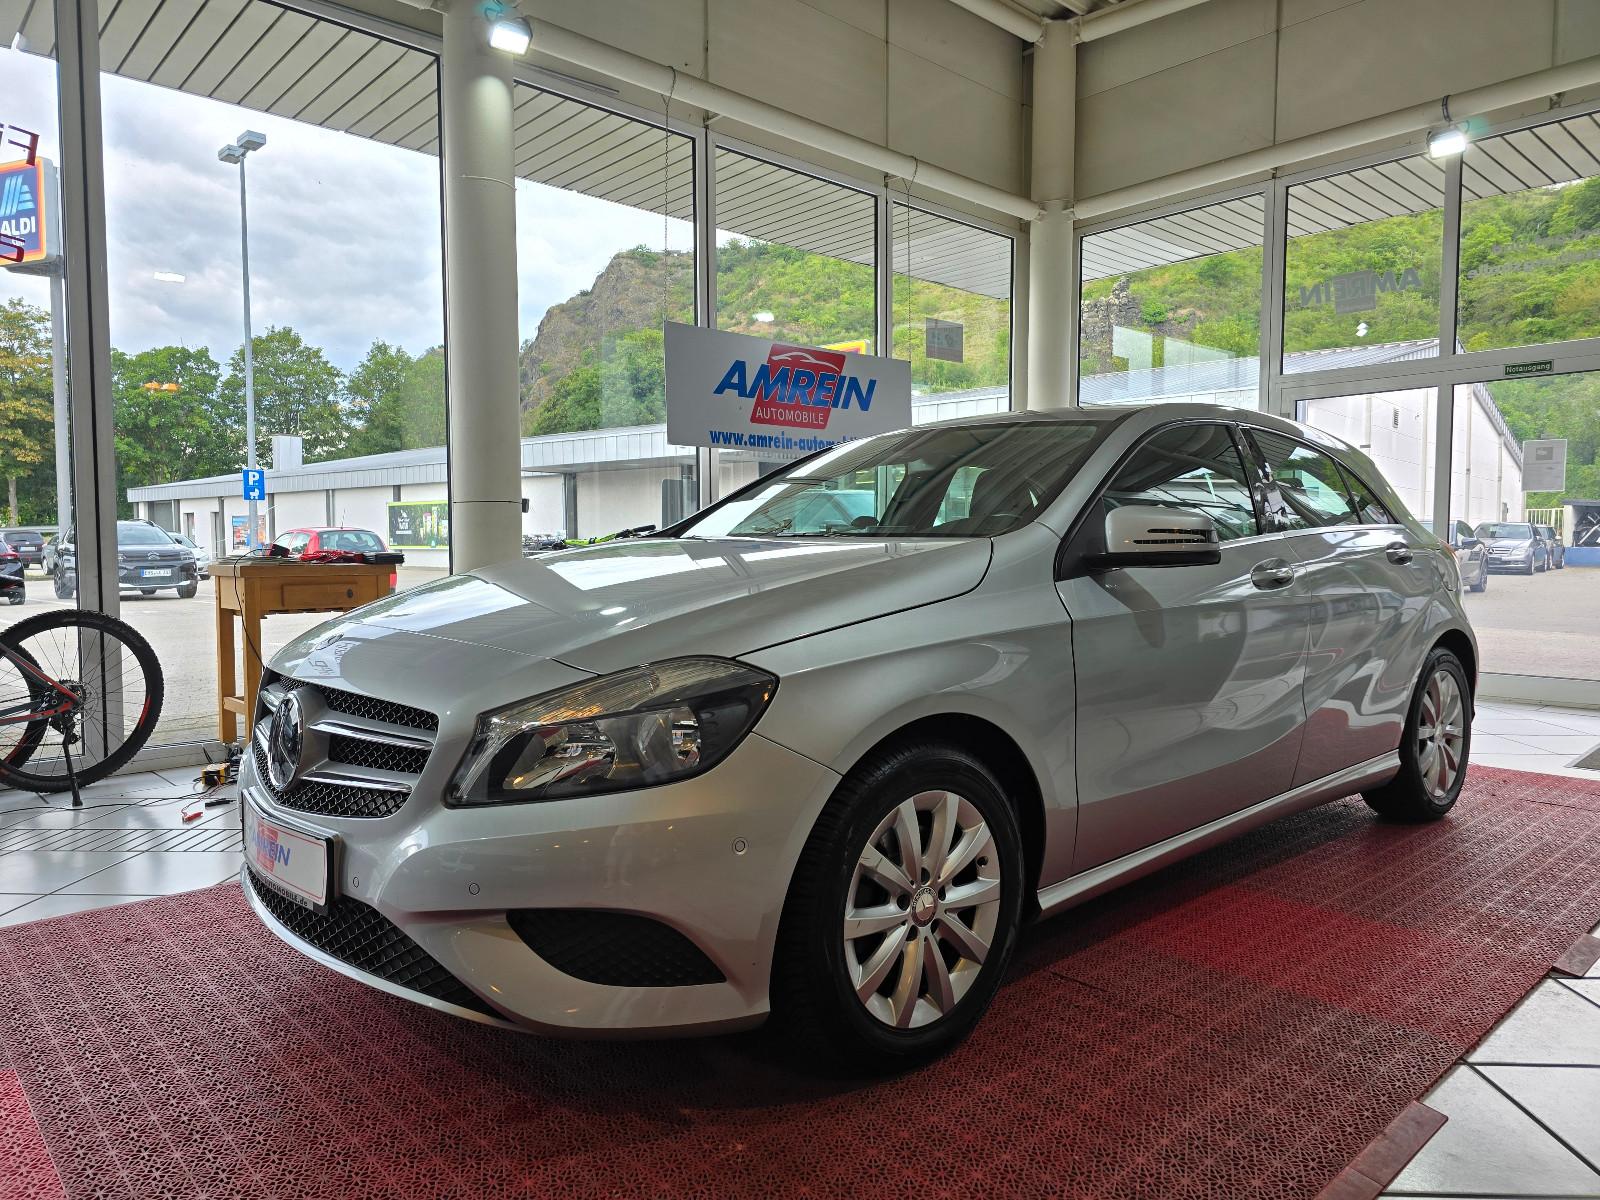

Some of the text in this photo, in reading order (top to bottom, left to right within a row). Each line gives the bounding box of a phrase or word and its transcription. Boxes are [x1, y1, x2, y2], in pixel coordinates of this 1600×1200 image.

[1, 215, 36, 236] ALDI
[1506, 364, 1551, 373] Notausgang
[713, 359, 877, 412] AMREIN
[755, 406, 825, 425] AUTOMOBILE
[248, 471, 260, 486] P
